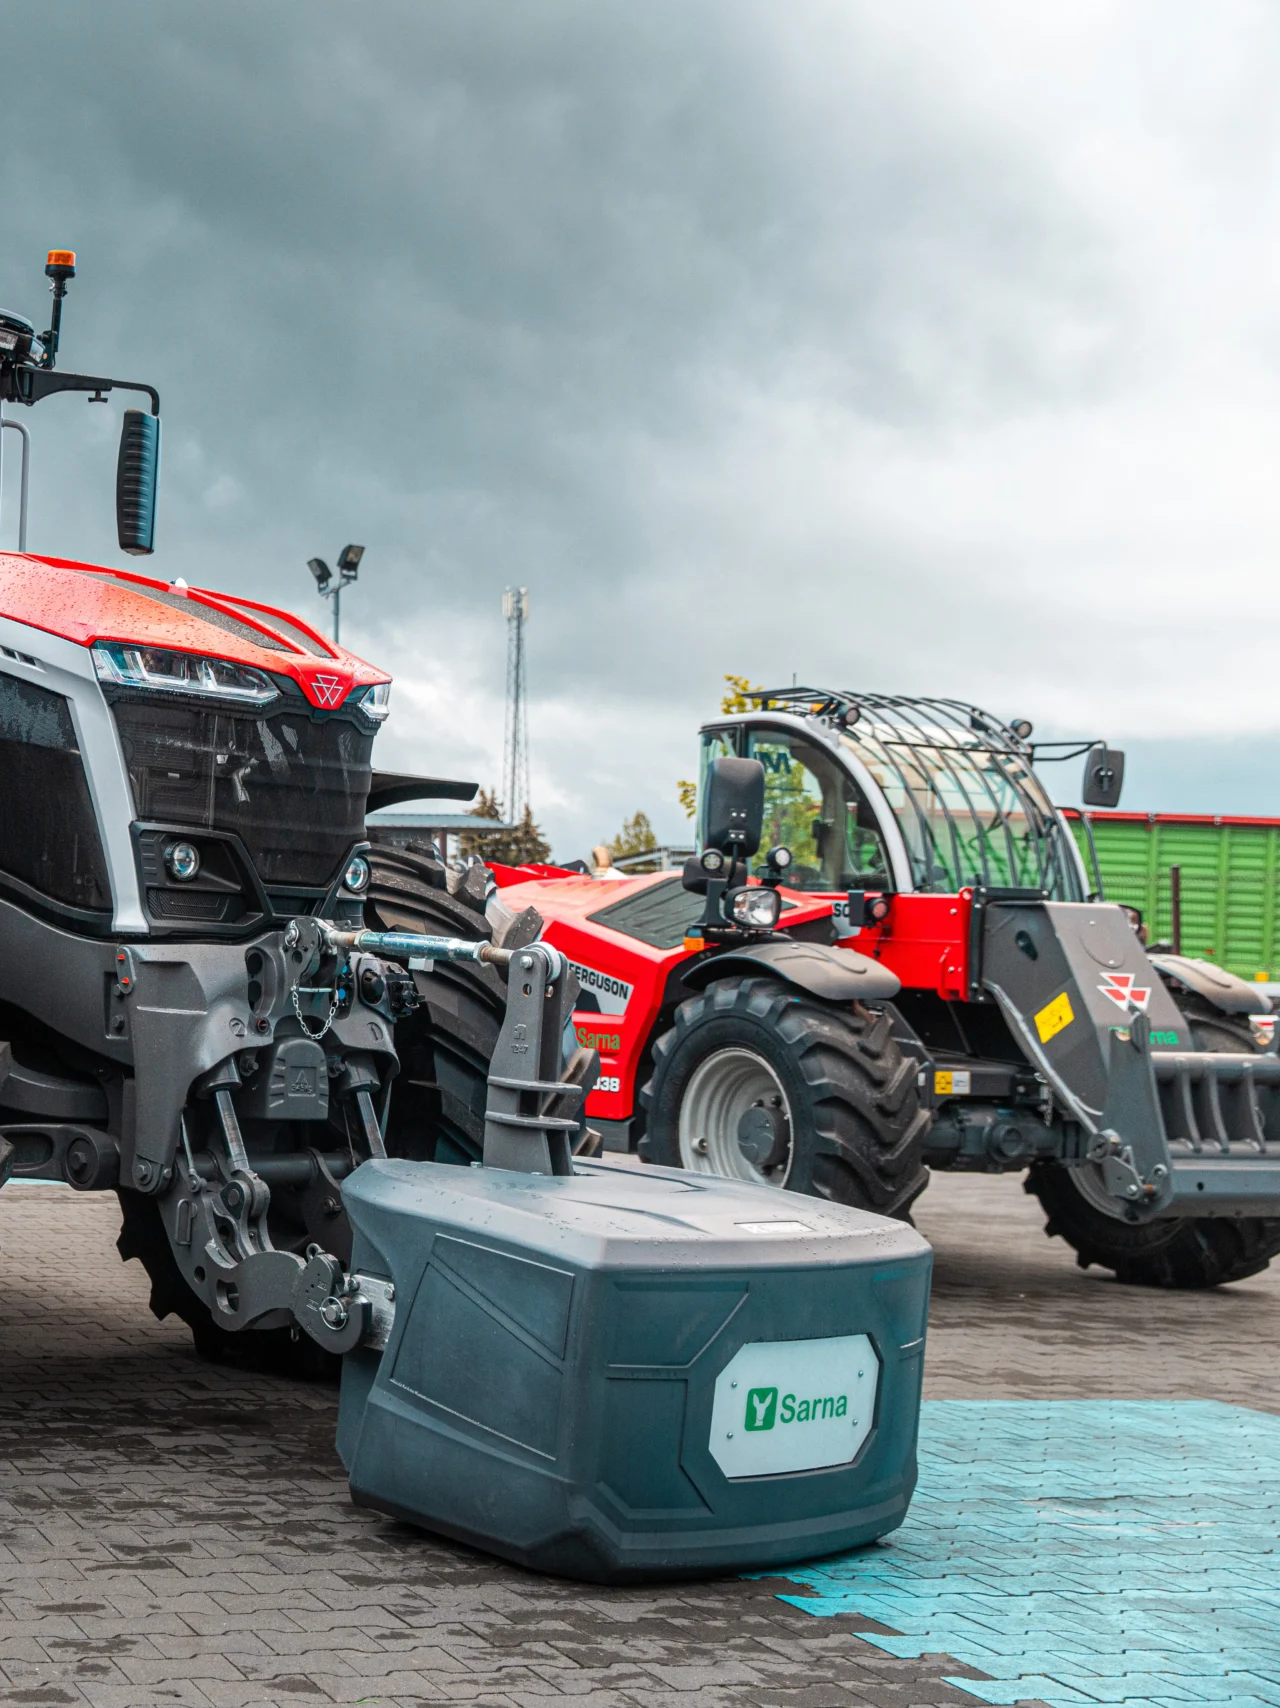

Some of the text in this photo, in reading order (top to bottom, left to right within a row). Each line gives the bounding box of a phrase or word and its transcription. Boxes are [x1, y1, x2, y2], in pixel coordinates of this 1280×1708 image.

[577, 1027, 621, 1050] Sarna
[1149, 1031, 1180, 1045] rna
[779, 1393, 848, 1424] Sarna
